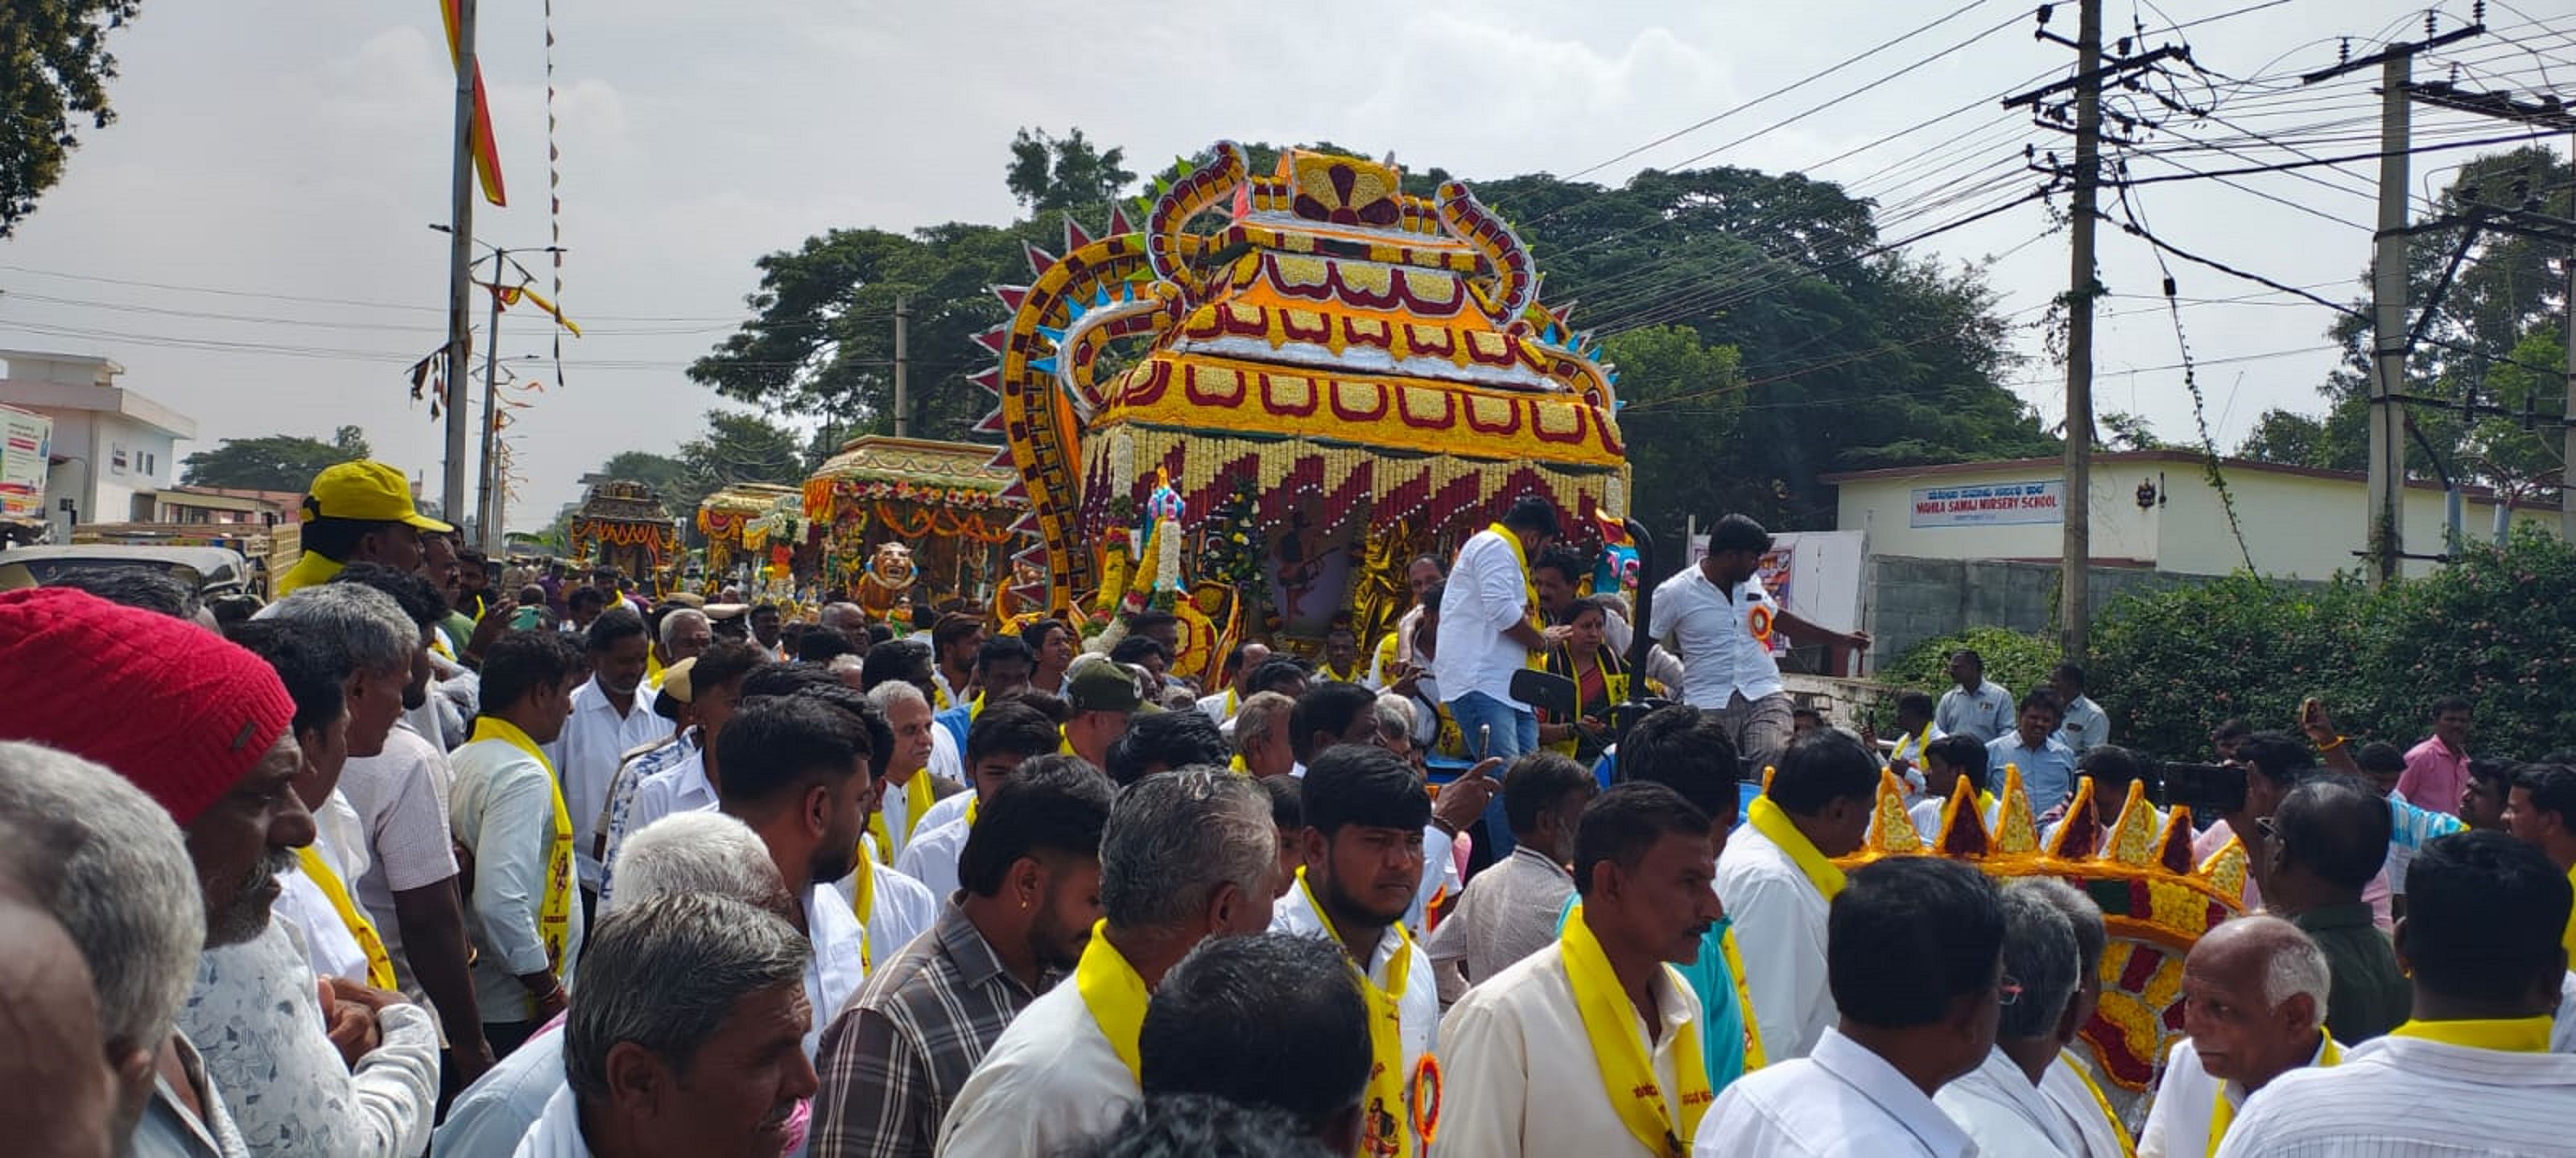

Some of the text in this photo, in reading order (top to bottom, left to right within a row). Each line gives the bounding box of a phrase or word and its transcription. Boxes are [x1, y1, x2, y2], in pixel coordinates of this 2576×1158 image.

[1947, 499, 1977, 513] SAMAJ
[1979, 497, 2018, 511] NURSERY
[2021, 494, 2058, 508] SCHOOL
